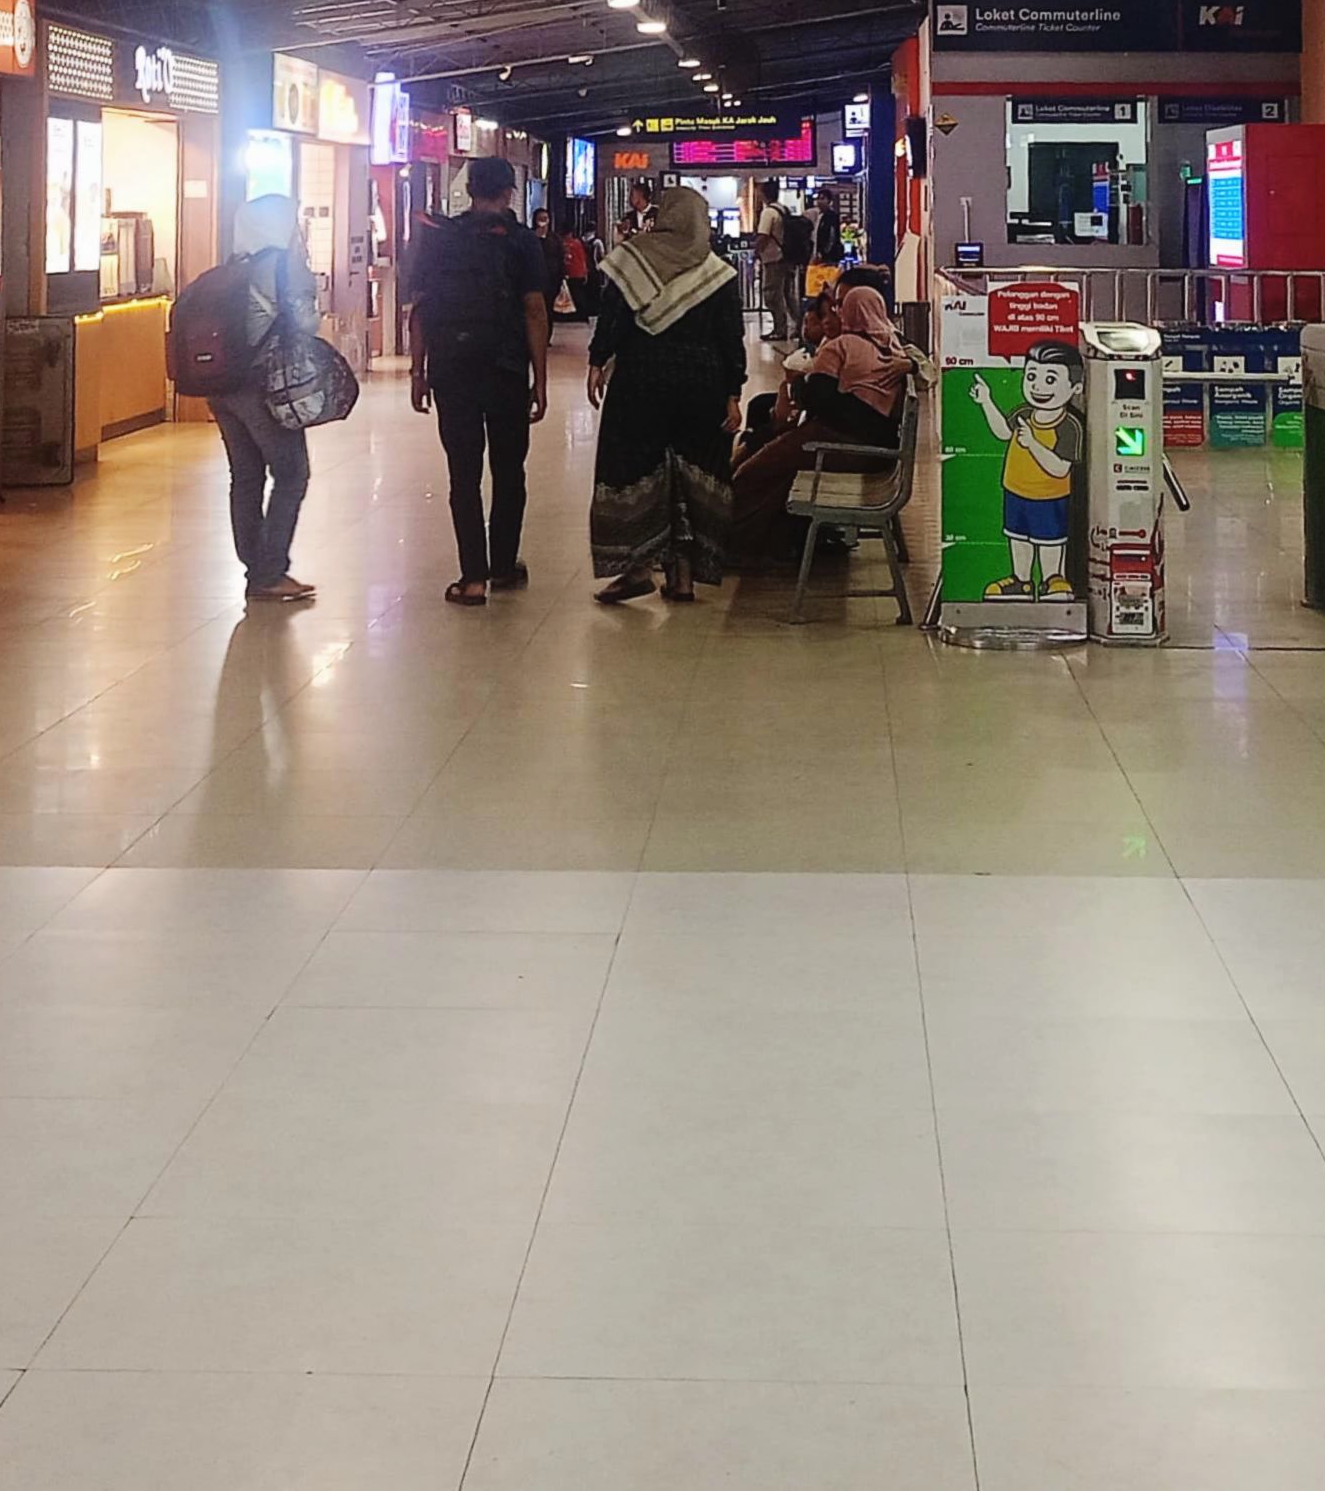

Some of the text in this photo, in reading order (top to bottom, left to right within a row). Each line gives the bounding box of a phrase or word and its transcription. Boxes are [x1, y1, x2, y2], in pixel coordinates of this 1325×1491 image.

[976, 7, 1121, 21] Loket Commuterline
[945, 356, 974, 366] 90 cm
